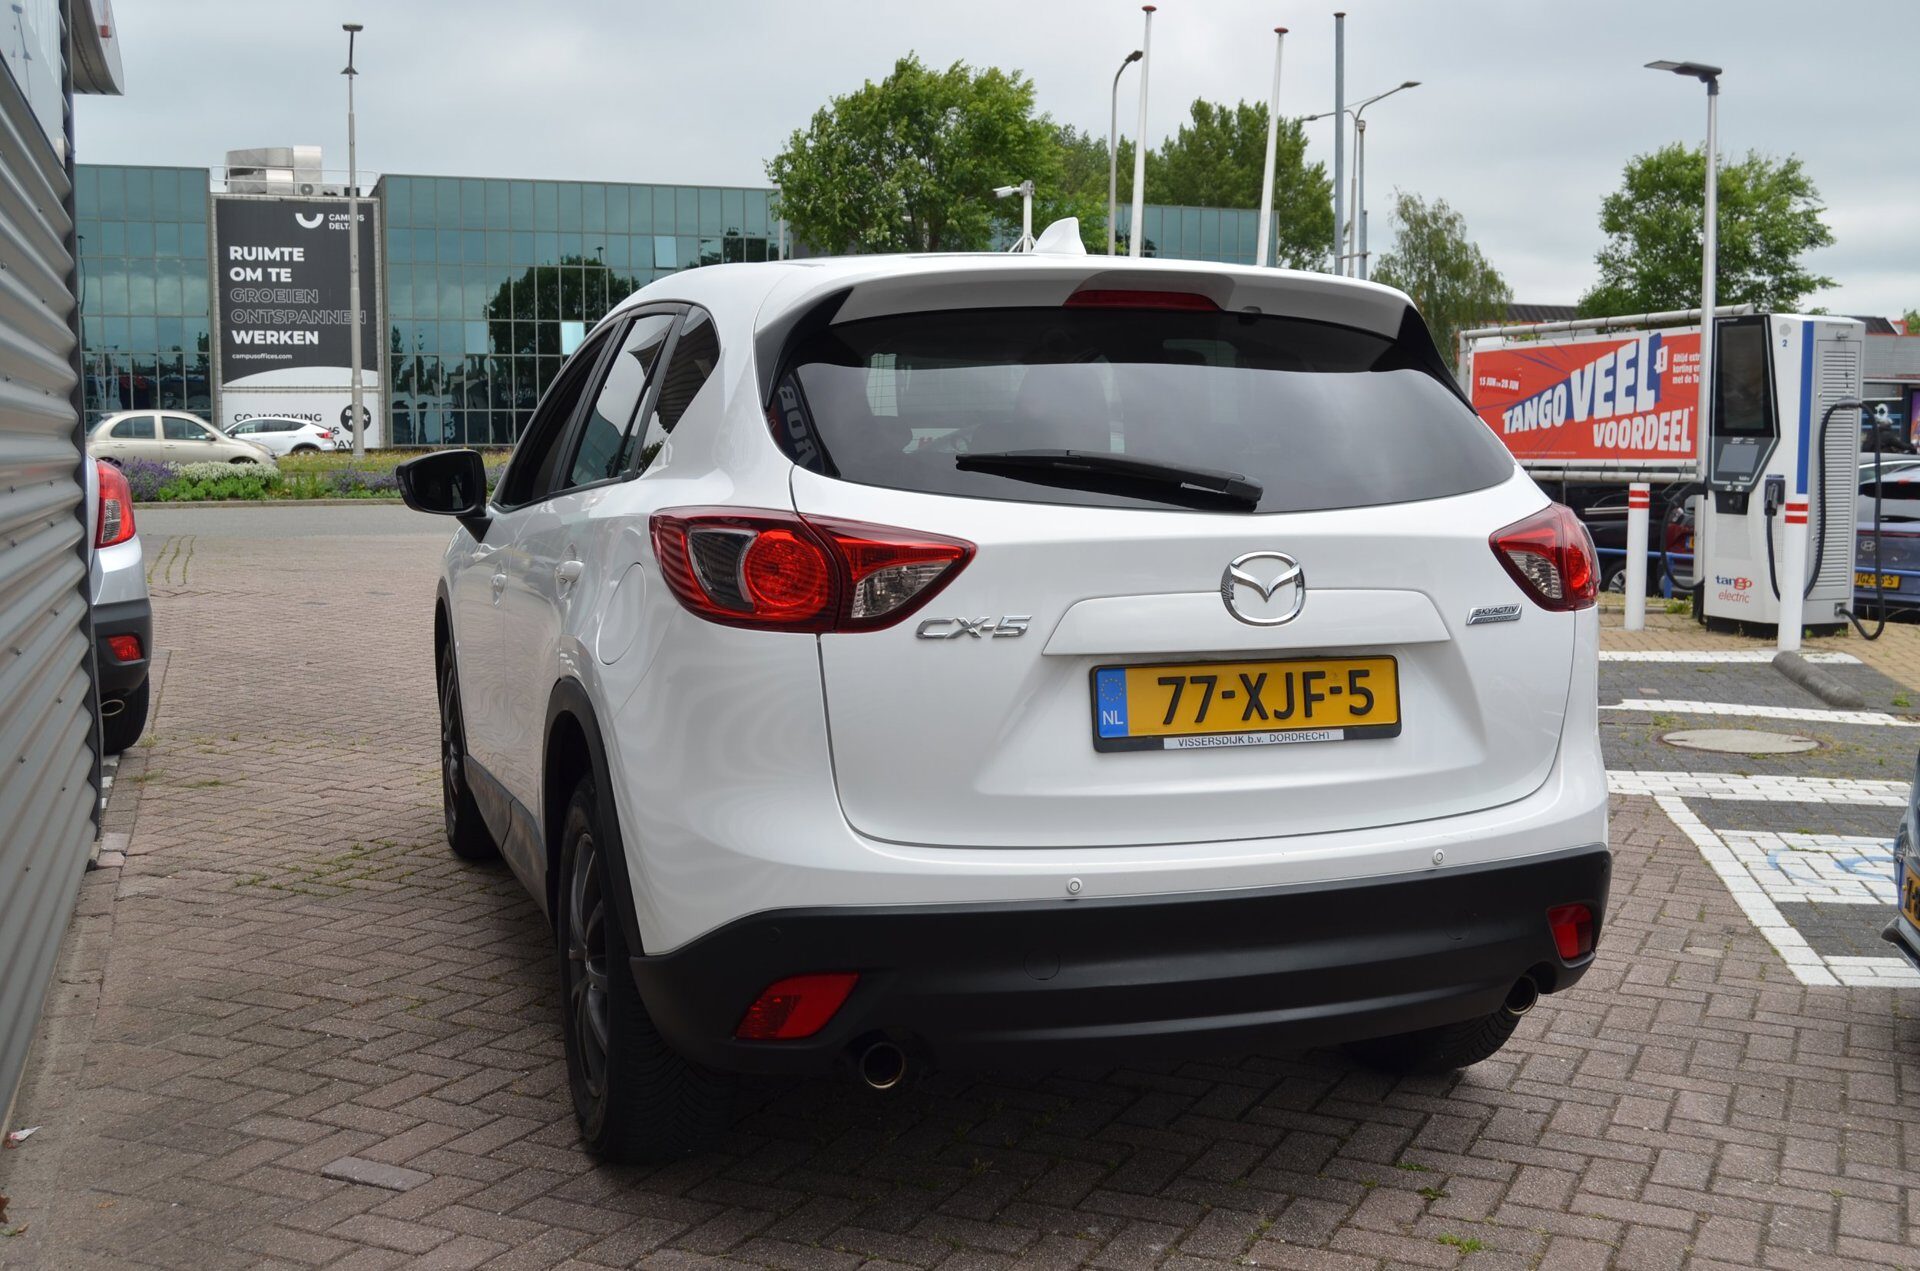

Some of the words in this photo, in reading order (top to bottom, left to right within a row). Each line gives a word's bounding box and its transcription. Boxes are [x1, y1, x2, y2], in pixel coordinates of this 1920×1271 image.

[328, 213, 365, 222] CAMS
[328, 222, 351, 230] DELT
[229, 246, 305, 262] RUIMTE
[229, 267, 263, 282] OM
[267, 268, 292, 282] TE
[230, 288, 319, 304] GROEIEN
[230, 308, 367, 325] ONTSPANNEN
[231, 330, 319, 345] WERKEN
[1782, 338, 1788, 347] 2
[1502, 382, 1567, 434] TANGO
[1570, 333, 1656, 423] VEEL
[1715, 575, 1752, 591] tango
[1718, 590, 1750, 604] electric
[1474, 606, 1518, 616] SKYACTIV
[916, 615, 1032, 639] CX-5
[1157, 669, 1375, 725] 77-XJF-5
[1102, 710, 1124, 725] NL
[1178, 735, 1246, 747] VISSERSDIJK
[1247, 735, 1264, 744] b.v.
[1269, 731, 1331, 743] DORDRECHT
